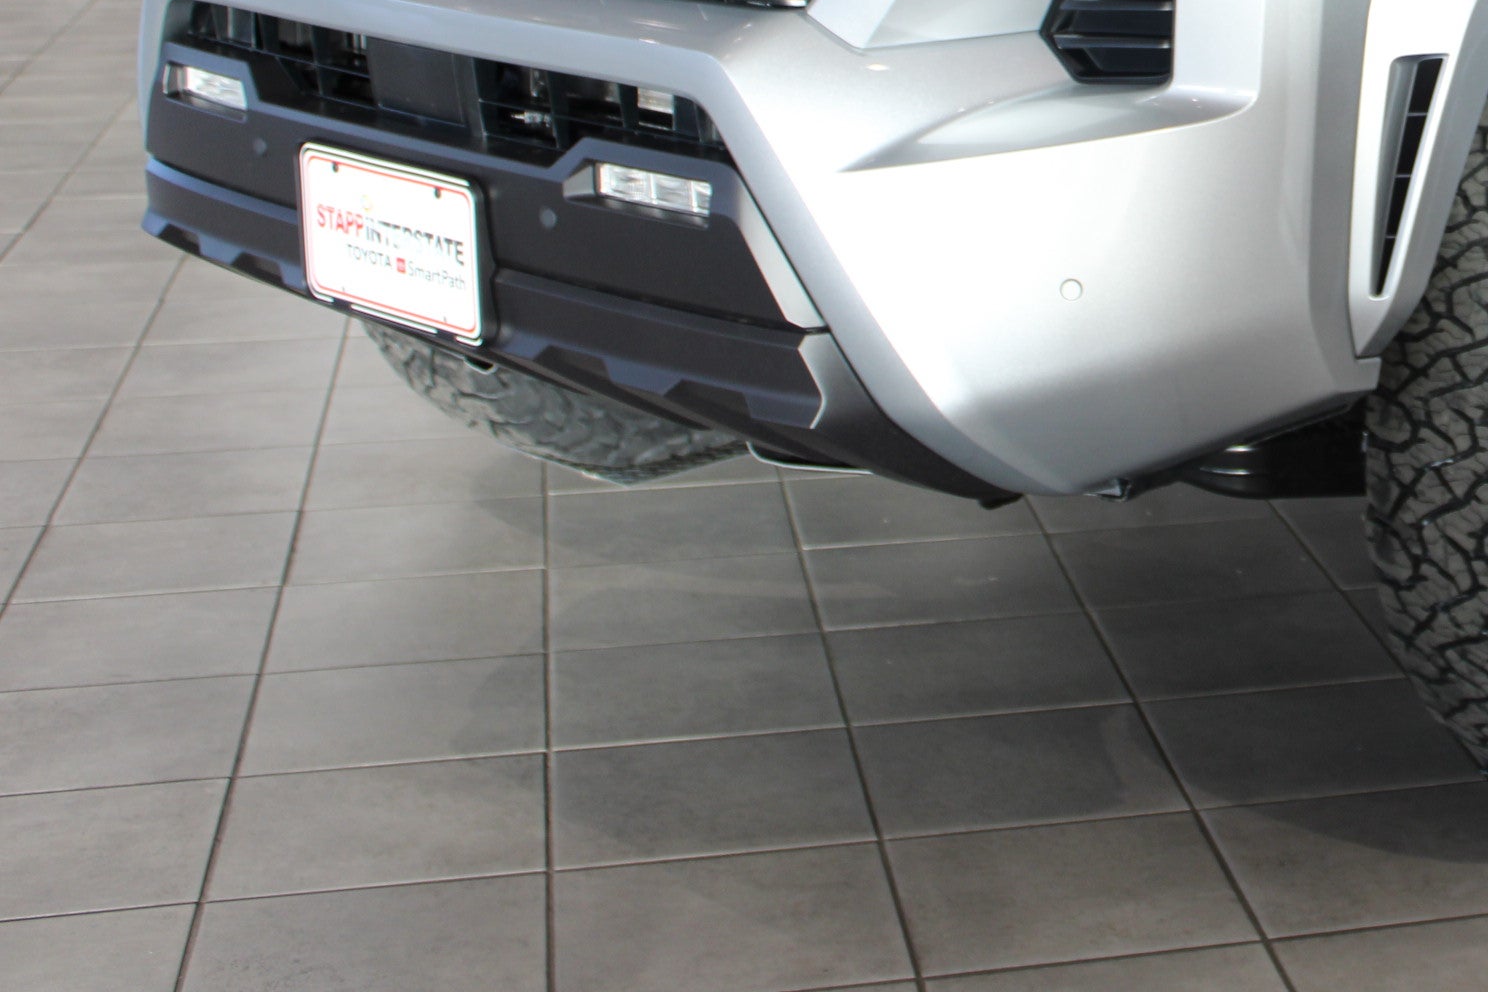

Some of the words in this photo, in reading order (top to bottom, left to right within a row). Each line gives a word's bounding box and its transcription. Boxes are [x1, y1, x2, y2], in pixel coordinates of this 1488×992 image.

[317, 204, 363, 236] STAPP
[347, 244, 392, 267] TOYOTA
[408, 260, 466, 290] SmartPath
